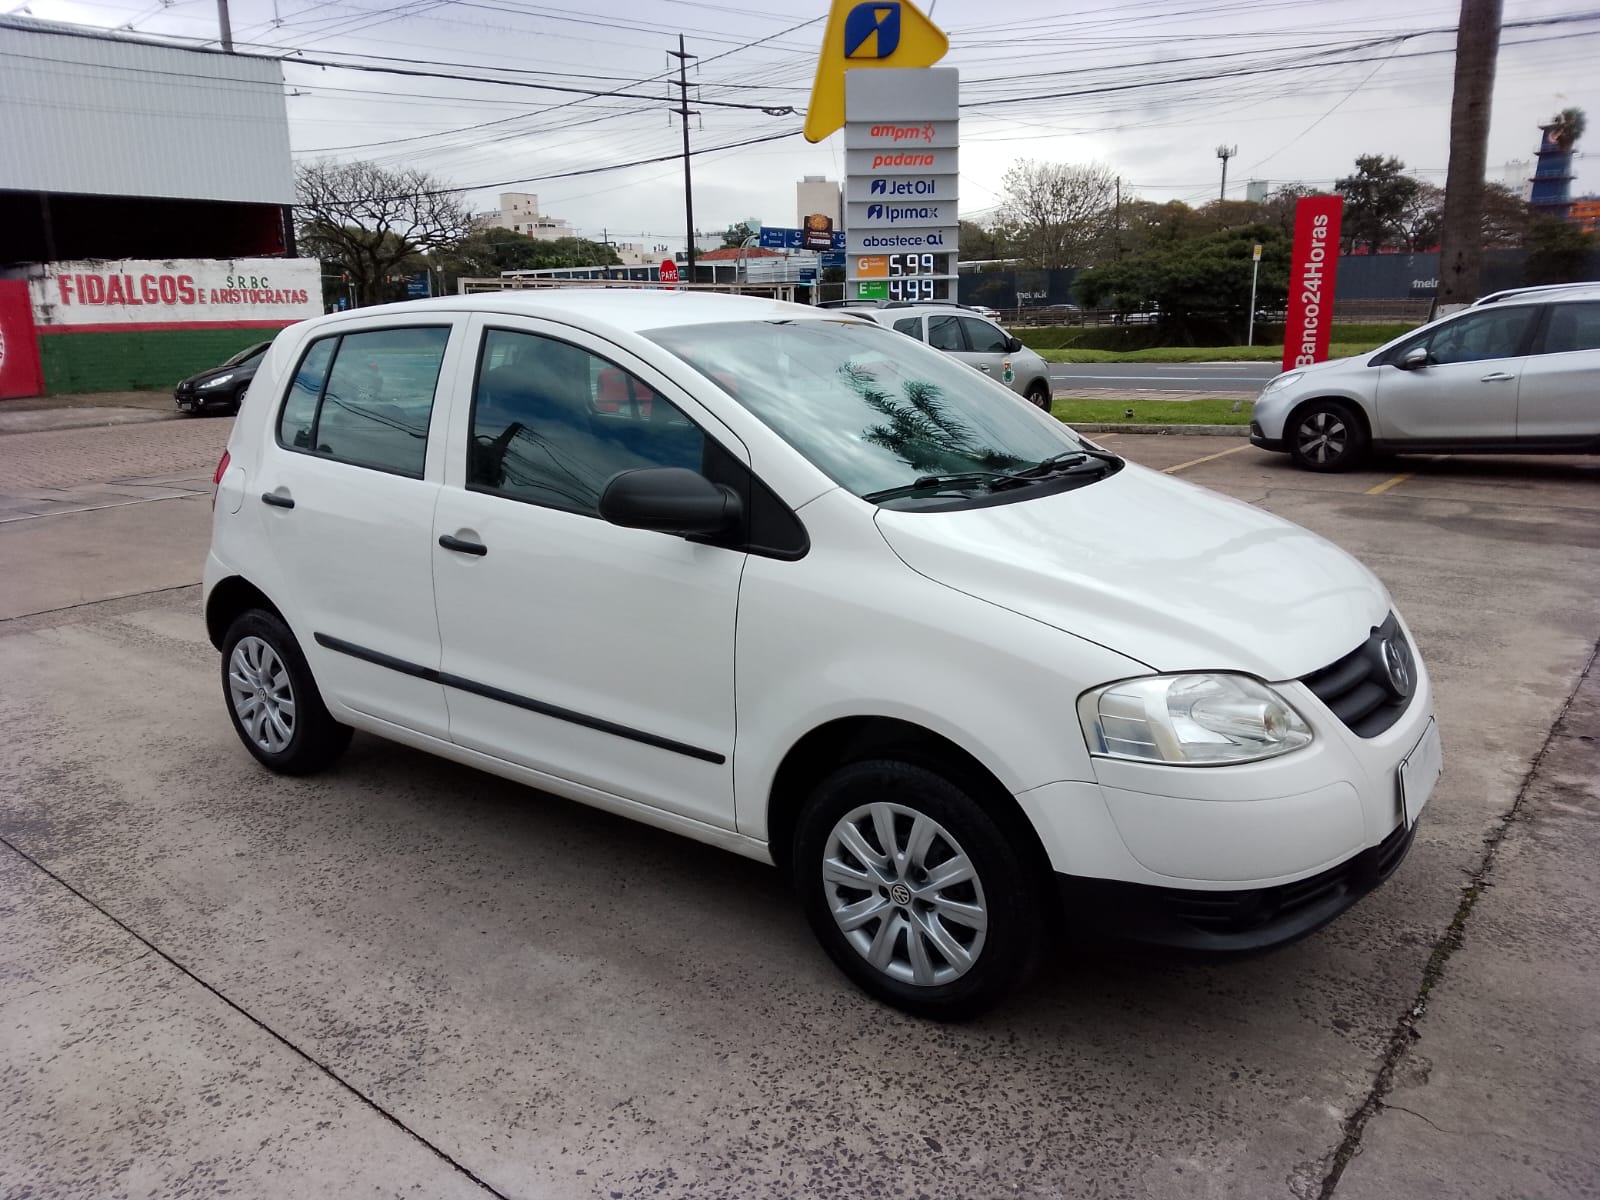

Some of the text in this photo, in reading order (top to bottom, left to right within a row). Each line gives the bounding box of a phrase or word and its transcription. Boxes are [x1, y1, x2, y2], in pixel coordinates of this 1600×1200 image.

[870, 125, 919, 141] ampm
[872, 153, 934, 169] padaria
[886, 206, 938, 222] Ipimax
[890, 254, 933, 276] 5.99
[661, 270, 677, 280] PARE
[57, 274, 195, 305] FIDALGOS
[198, 288, 308, 304] E ARISTOCRATAS
[890, 280, 933, 301] 4.99
[1295, 214, 1328, 368] Banco24Horas
